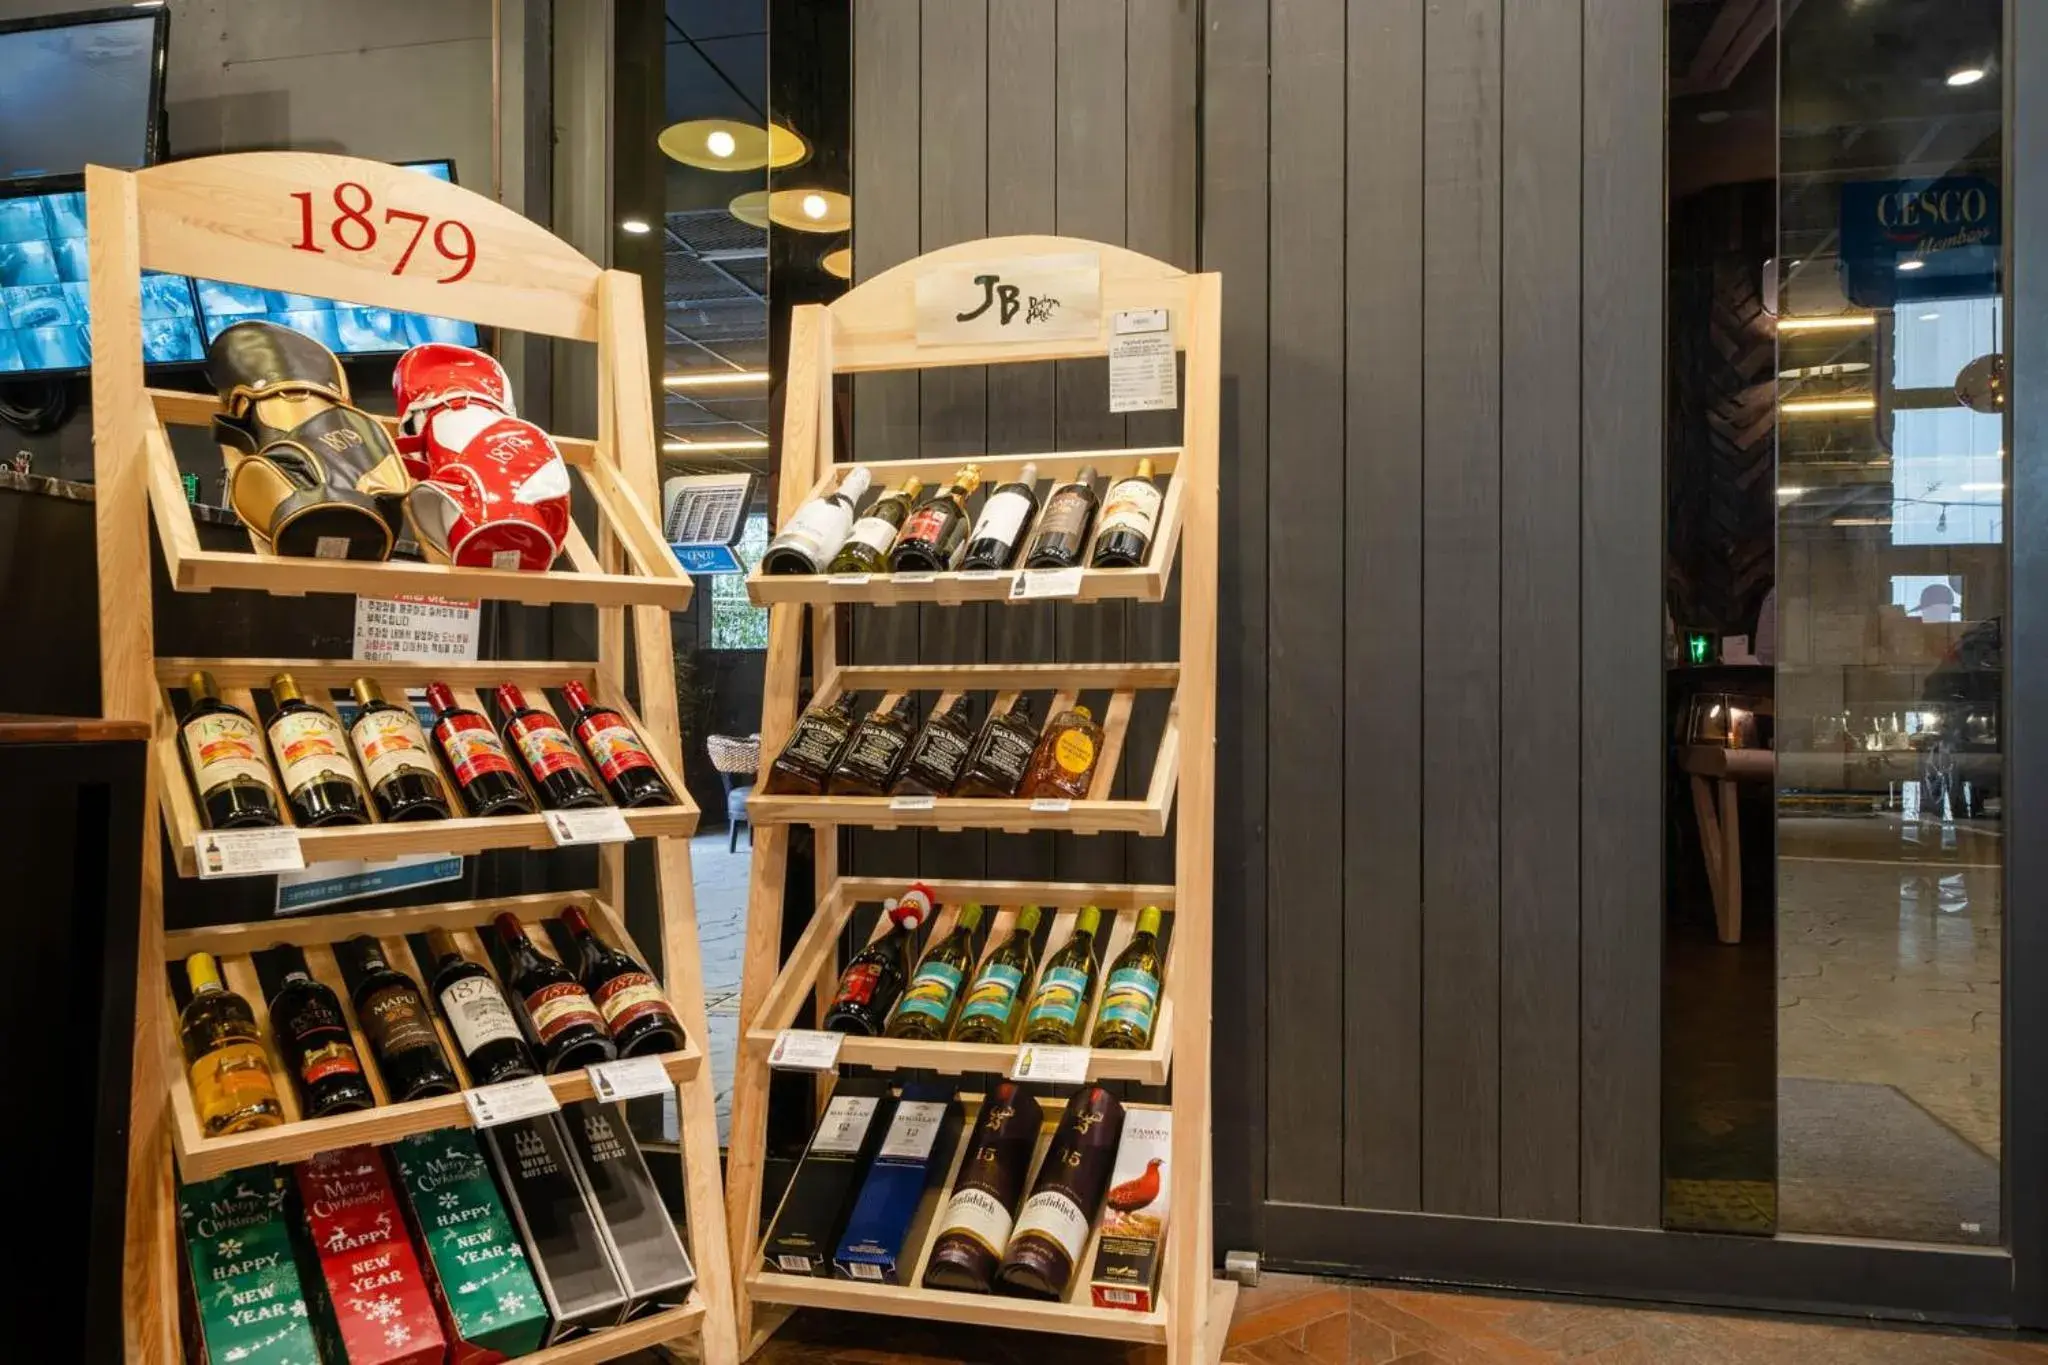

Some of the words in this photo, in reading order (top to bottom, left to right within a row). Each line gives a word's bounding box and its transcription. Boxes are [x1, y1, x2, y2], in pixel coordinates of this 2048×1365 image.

[1877, 187, 1987, 229] CESCO
[290, 182, 476, 284] 1879
[956, 274, 1020, 325] JB
[318, 428, 363, 452] 1879
[485, 436, 531, 465] 1879
[373, 996, 415, 1015] MAPU
[977, 1146, 997, 1161] 15
[1062, 1148, 1083, 1167] 15
[437, 1203, 492, 1227] HAPPY
[332, 1227, 392, 1253] HAPPY
[457, 1228, 494, 1249] NEW
[213, 1252, 280, 1280] HAPPY
[352, 1253, 391, 1275] NEW
[457, 1245, 504, 1266] YEAR
[351, 1270, 403, 1293] YEAR
[232, 1283, 276, 1307] NEW
[228, 1303, 287, 1327] YEAR
